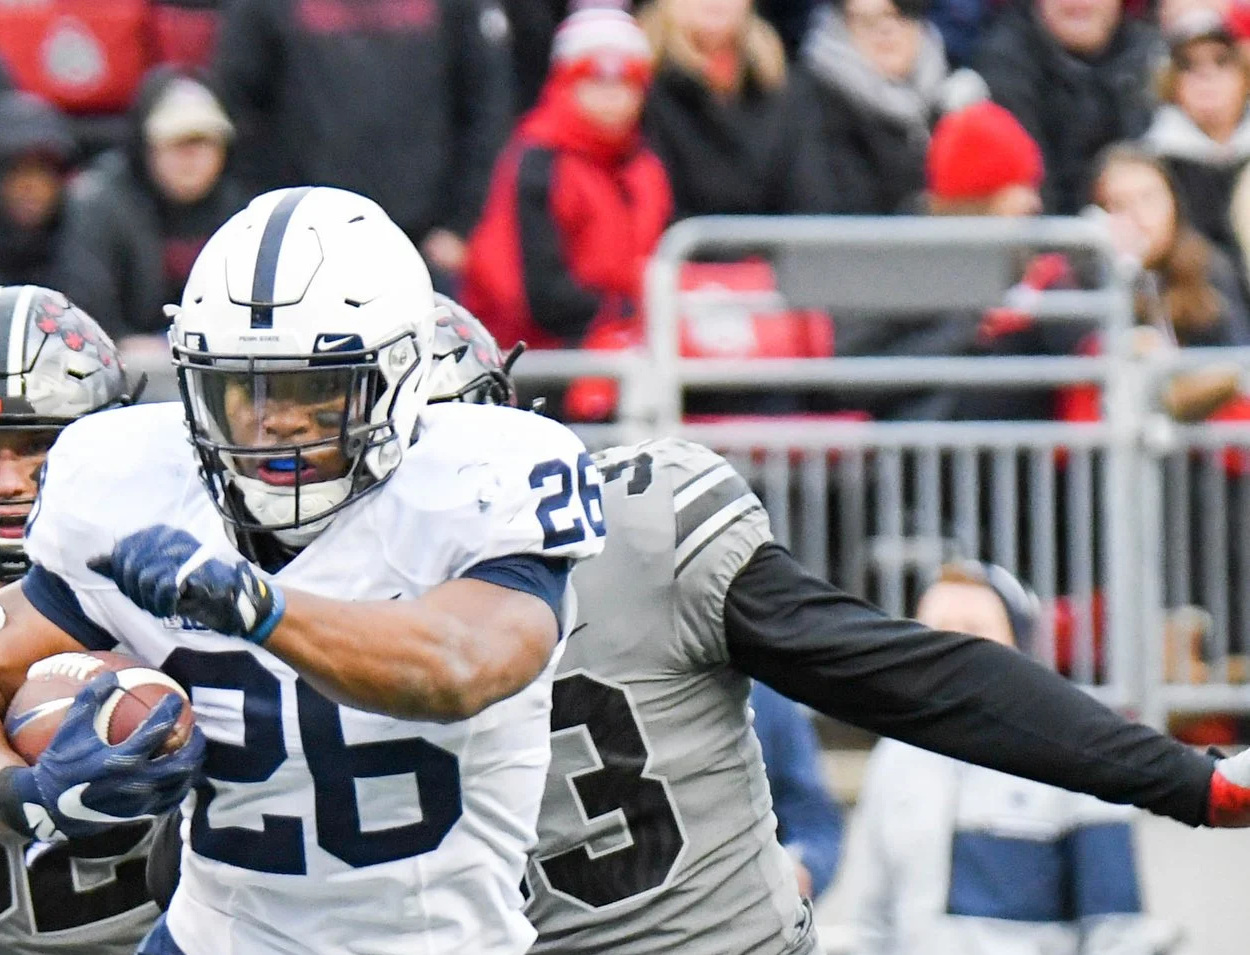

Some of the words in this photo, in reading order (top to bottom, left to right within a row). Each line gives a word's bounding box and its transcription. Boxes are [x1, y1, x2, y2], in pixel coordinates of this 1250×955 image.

[528, 451, 607, 550] 26
[160, 647, 463, 876] 26
[519, 668, 689, 911] 3
